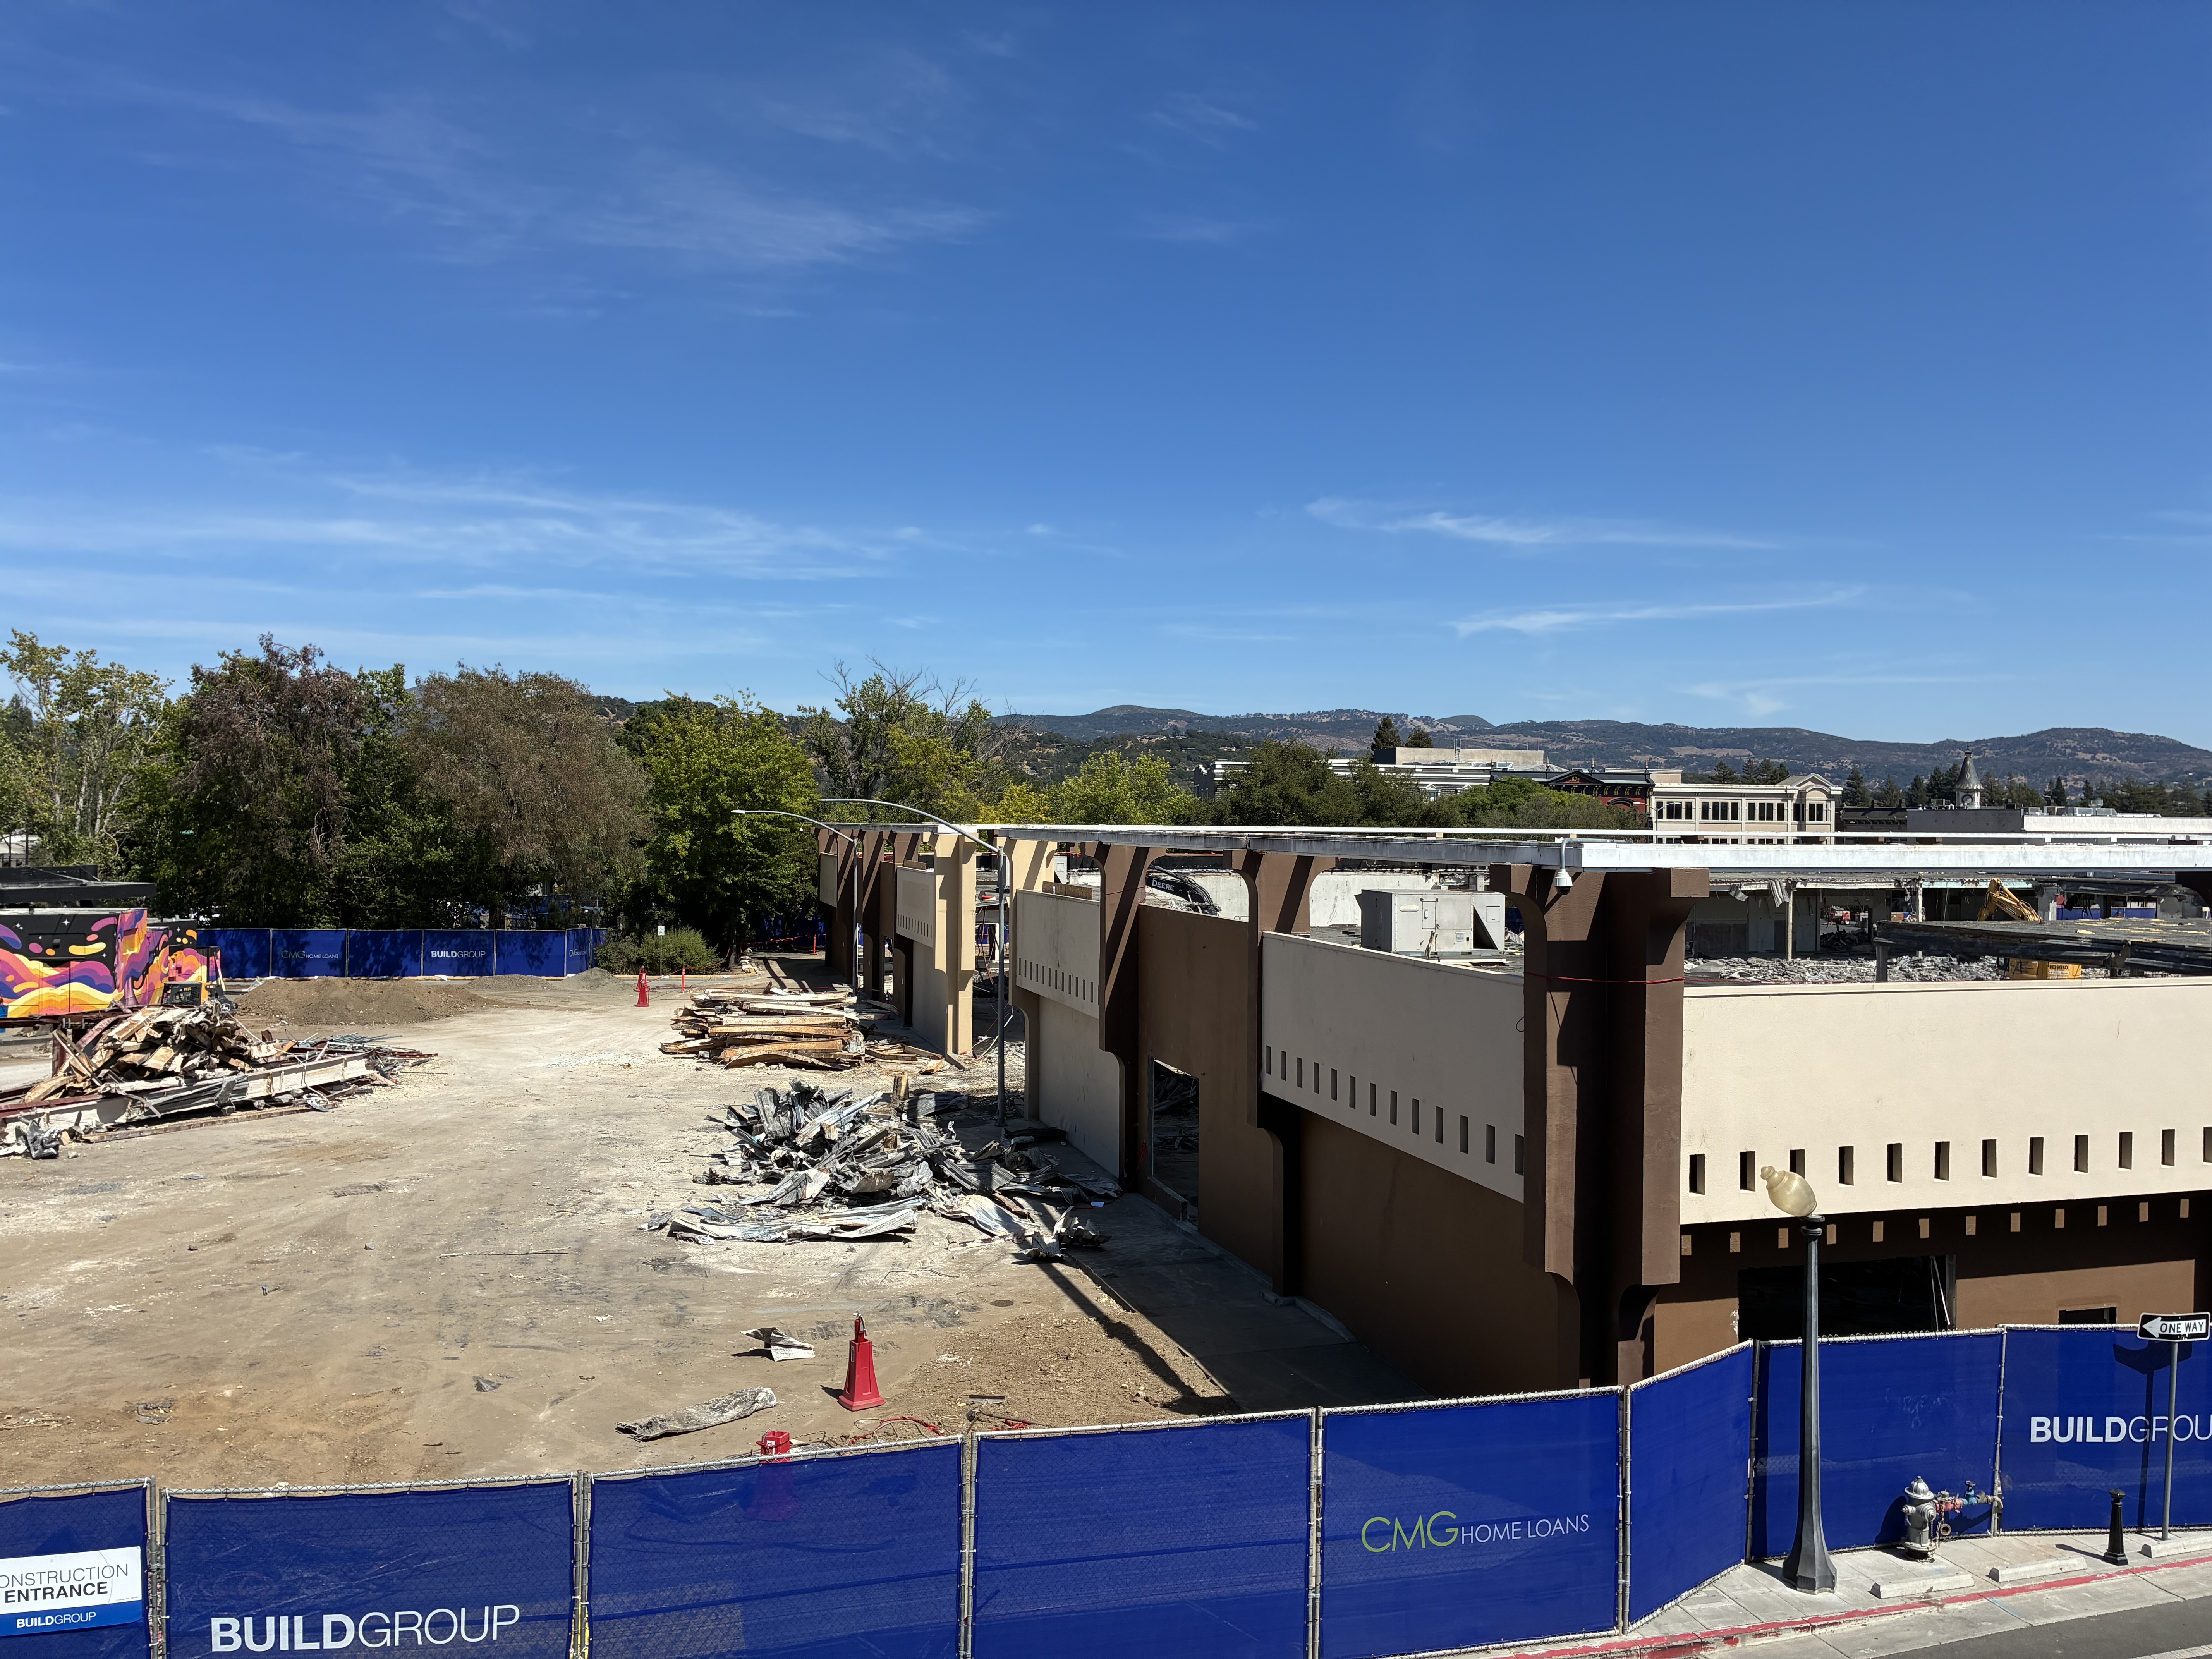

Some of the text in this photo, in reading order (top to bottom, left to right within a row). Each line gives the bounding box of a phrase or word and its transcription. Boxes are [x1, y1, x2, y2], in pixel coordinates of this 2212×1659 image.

[1152, 879, 1175, 891] DEERE
[281, 950, 306, 958] CMG
[2160, 1321, 2204, 1333] ONE WAY
[2030, 1415, 2212, 1442] BUILDGROU
[1361, 1511, 1589, 1552] CMG HOME LOANS
[0, 1564, 127, 1588] ONSTRUCTION
[5, 1582, 108, 1603] ENTRANCE
[17, 1611, 96, 1628] BUILDGROUP
[211, 1604, 520, 1652] BUILDGROUP
